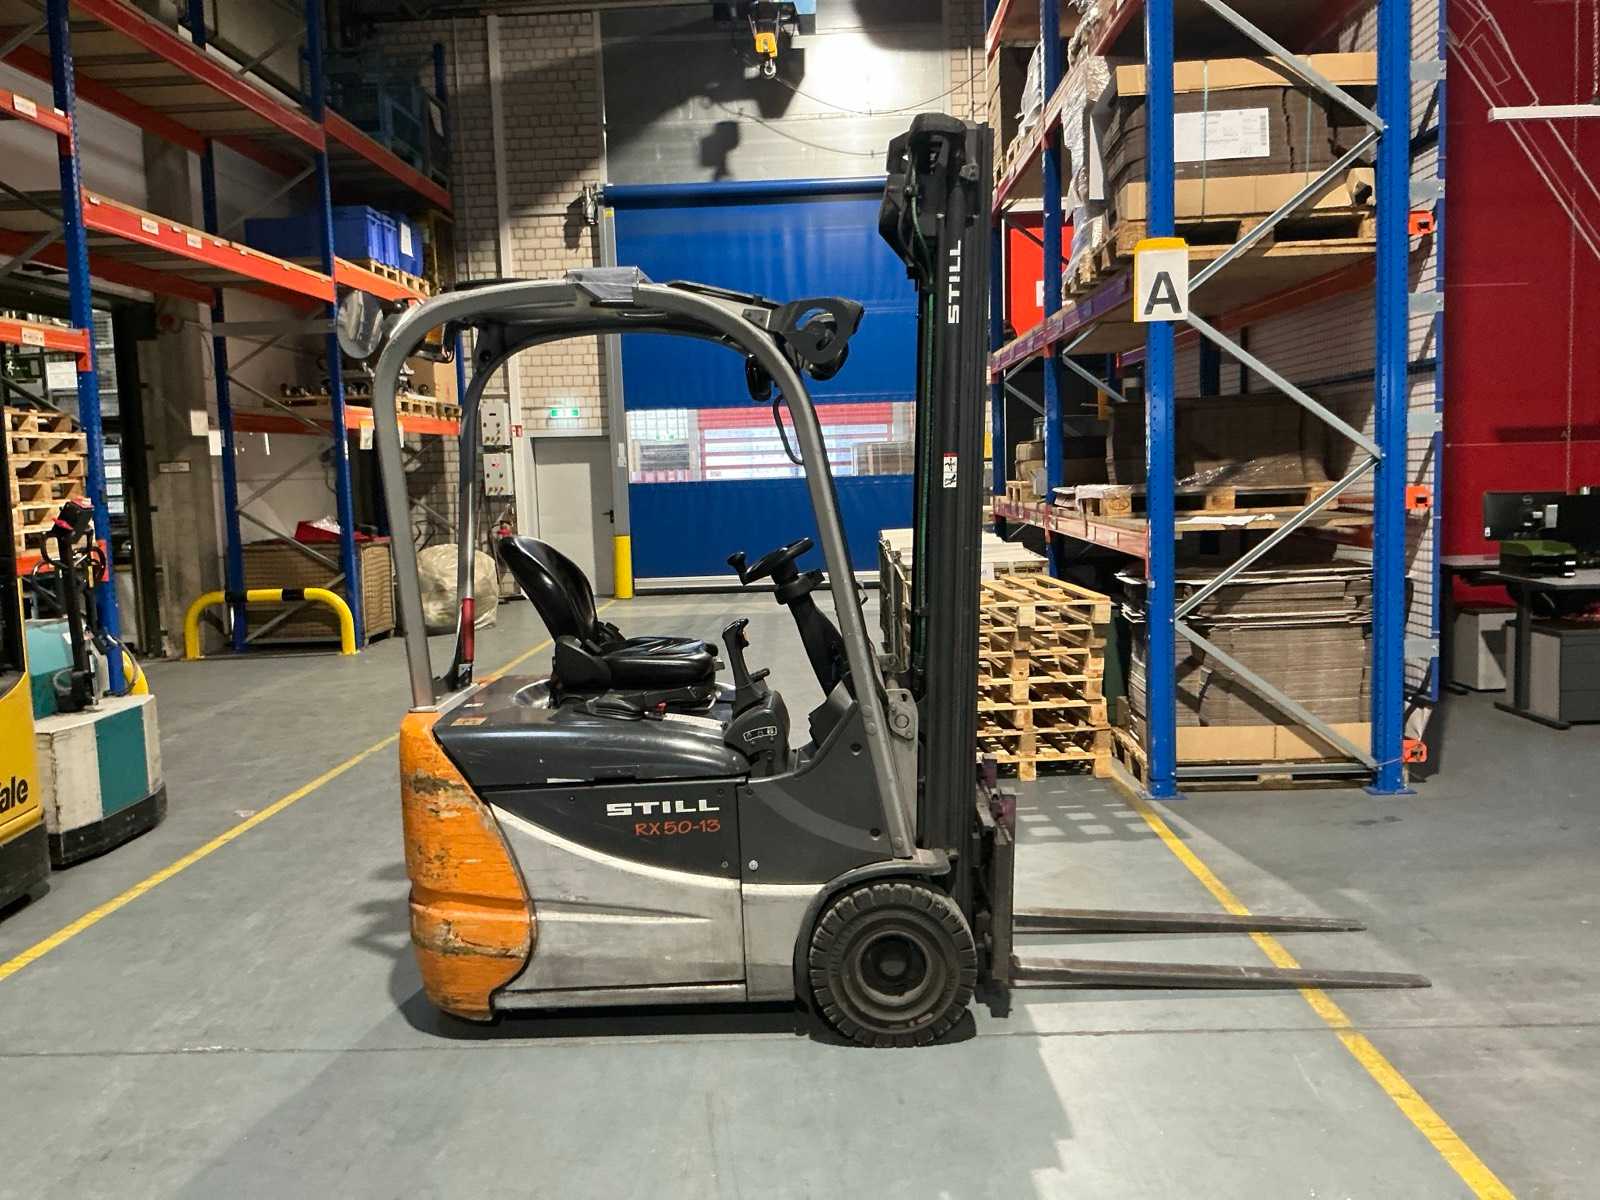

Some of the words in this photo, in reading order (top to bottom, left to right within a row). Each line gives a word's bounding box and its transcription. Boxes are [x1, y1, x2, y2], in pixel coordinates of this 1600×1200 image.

[947, 239, 962, 324] STILL
[1143, 271, 1183, 315] A
[0, 775, 29, 814] ale
[606, 799, 720, 817] STILL
